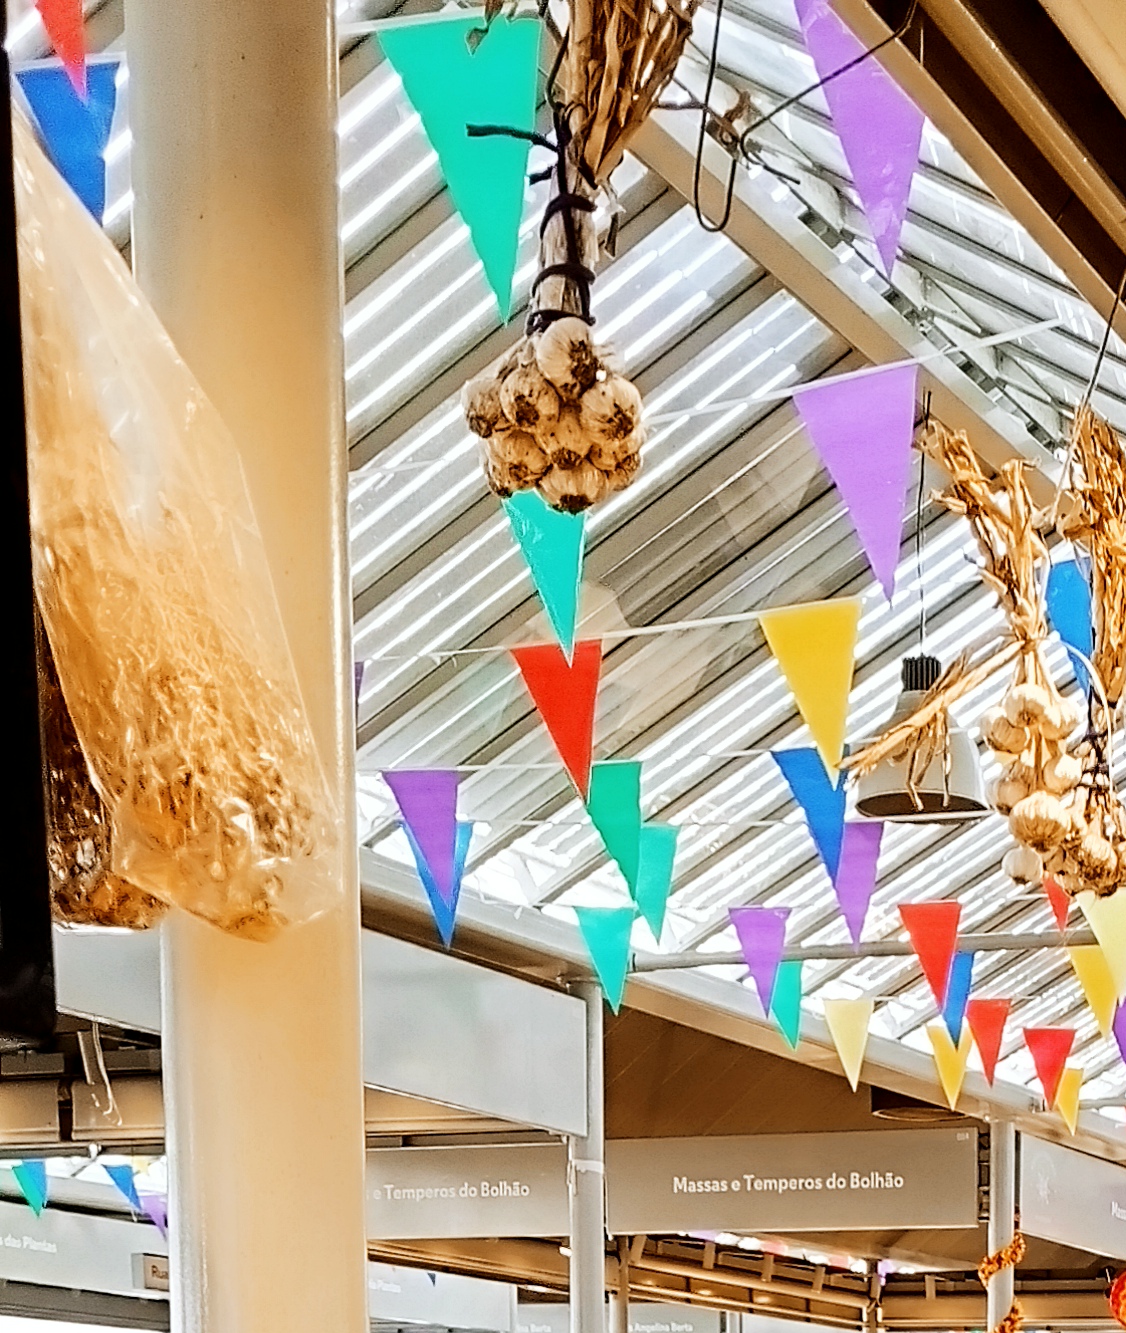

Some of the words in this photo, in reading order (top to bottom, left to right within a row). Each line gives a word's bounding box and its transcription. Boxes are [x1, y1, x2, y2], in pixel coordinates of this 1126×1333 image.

[383, 1184, 456, 1202] Temperos
[459, 1182, 478, 1198] do
[481, 1180, 530, 1198] Bolhão
[673, 1176, 728, 1194] Massas
[731, 1179, 741, 1192] e
[743, 1174, 823, 1194] Temperos
[826, 1173, 847, 1190] do
[850, 1171, 904, 1189] Bolhão
